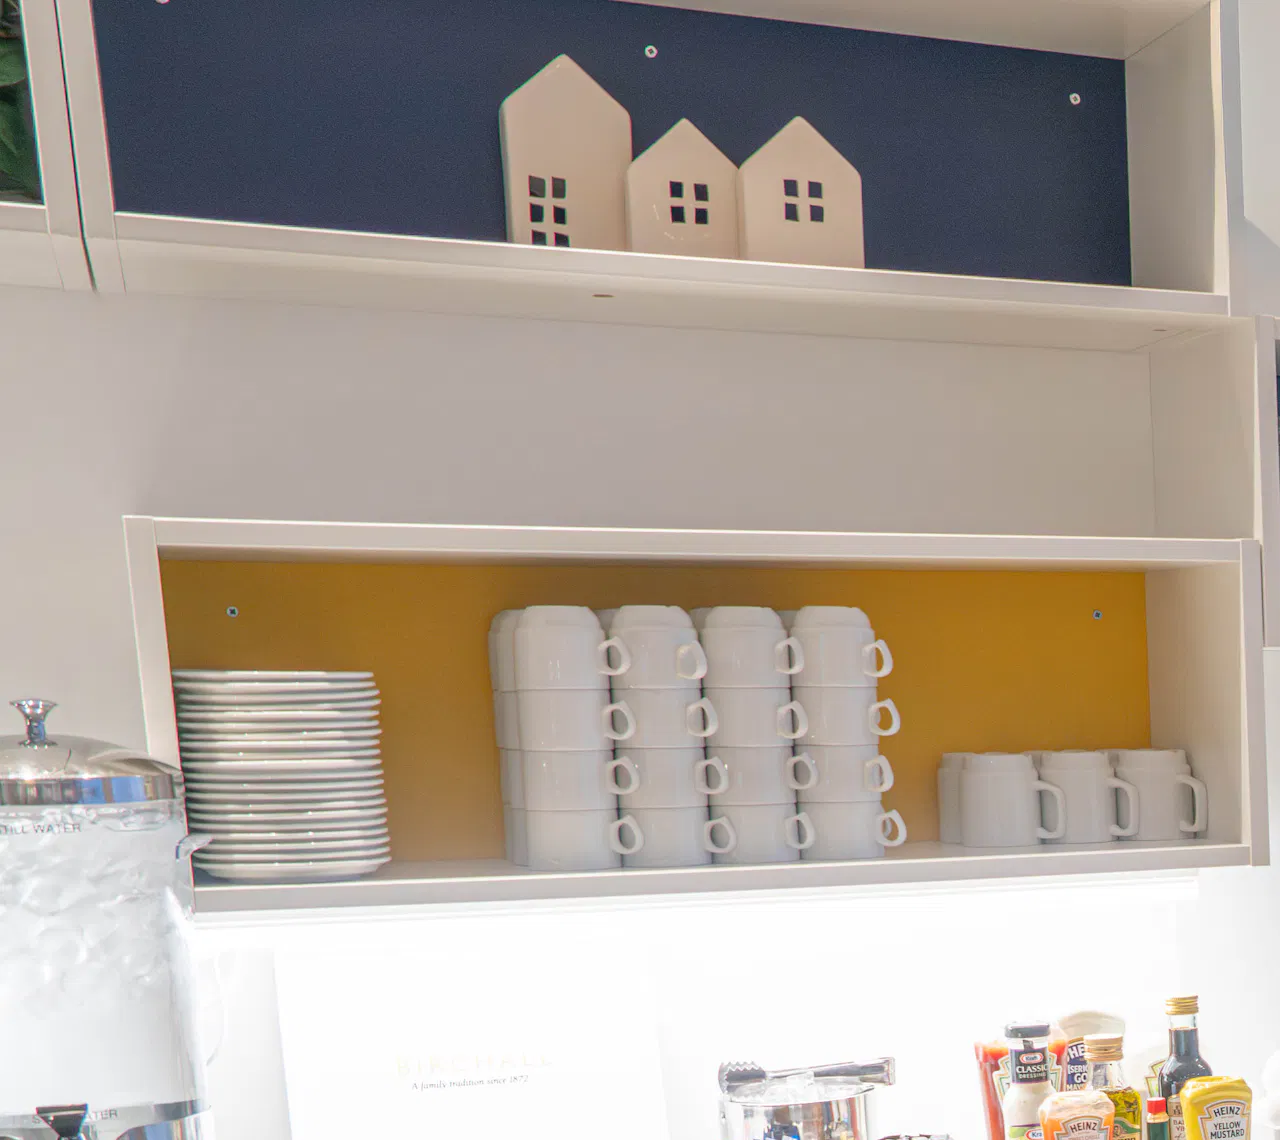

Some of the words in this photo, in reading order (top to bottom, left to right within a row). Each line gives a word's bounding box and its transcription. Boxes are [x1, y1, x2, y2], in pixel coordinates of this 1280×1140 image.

[0, 824, 27, 835] TILL
[32, 823, 81, 834] WATER
[1068, 1043, 1085, 1060] HE
[411, 1082, 419, 1091] A
[421, 1079, 447, 1092] family
[449, 1077, 484, 1088] tradition
[487, 1076, 507, 1085] since
[509, 1074, 529, 1084] 1872
[1074, 1073, 1088, 1084] GO
[1213, 1106, 1241, 1117] HEINZ
[1069, 1121, 1098, 1133] HEINZ
[1213, 1121, 1242, 1130] YELLOW
[1210, 1129, 1245, 1139] MUSTARD
